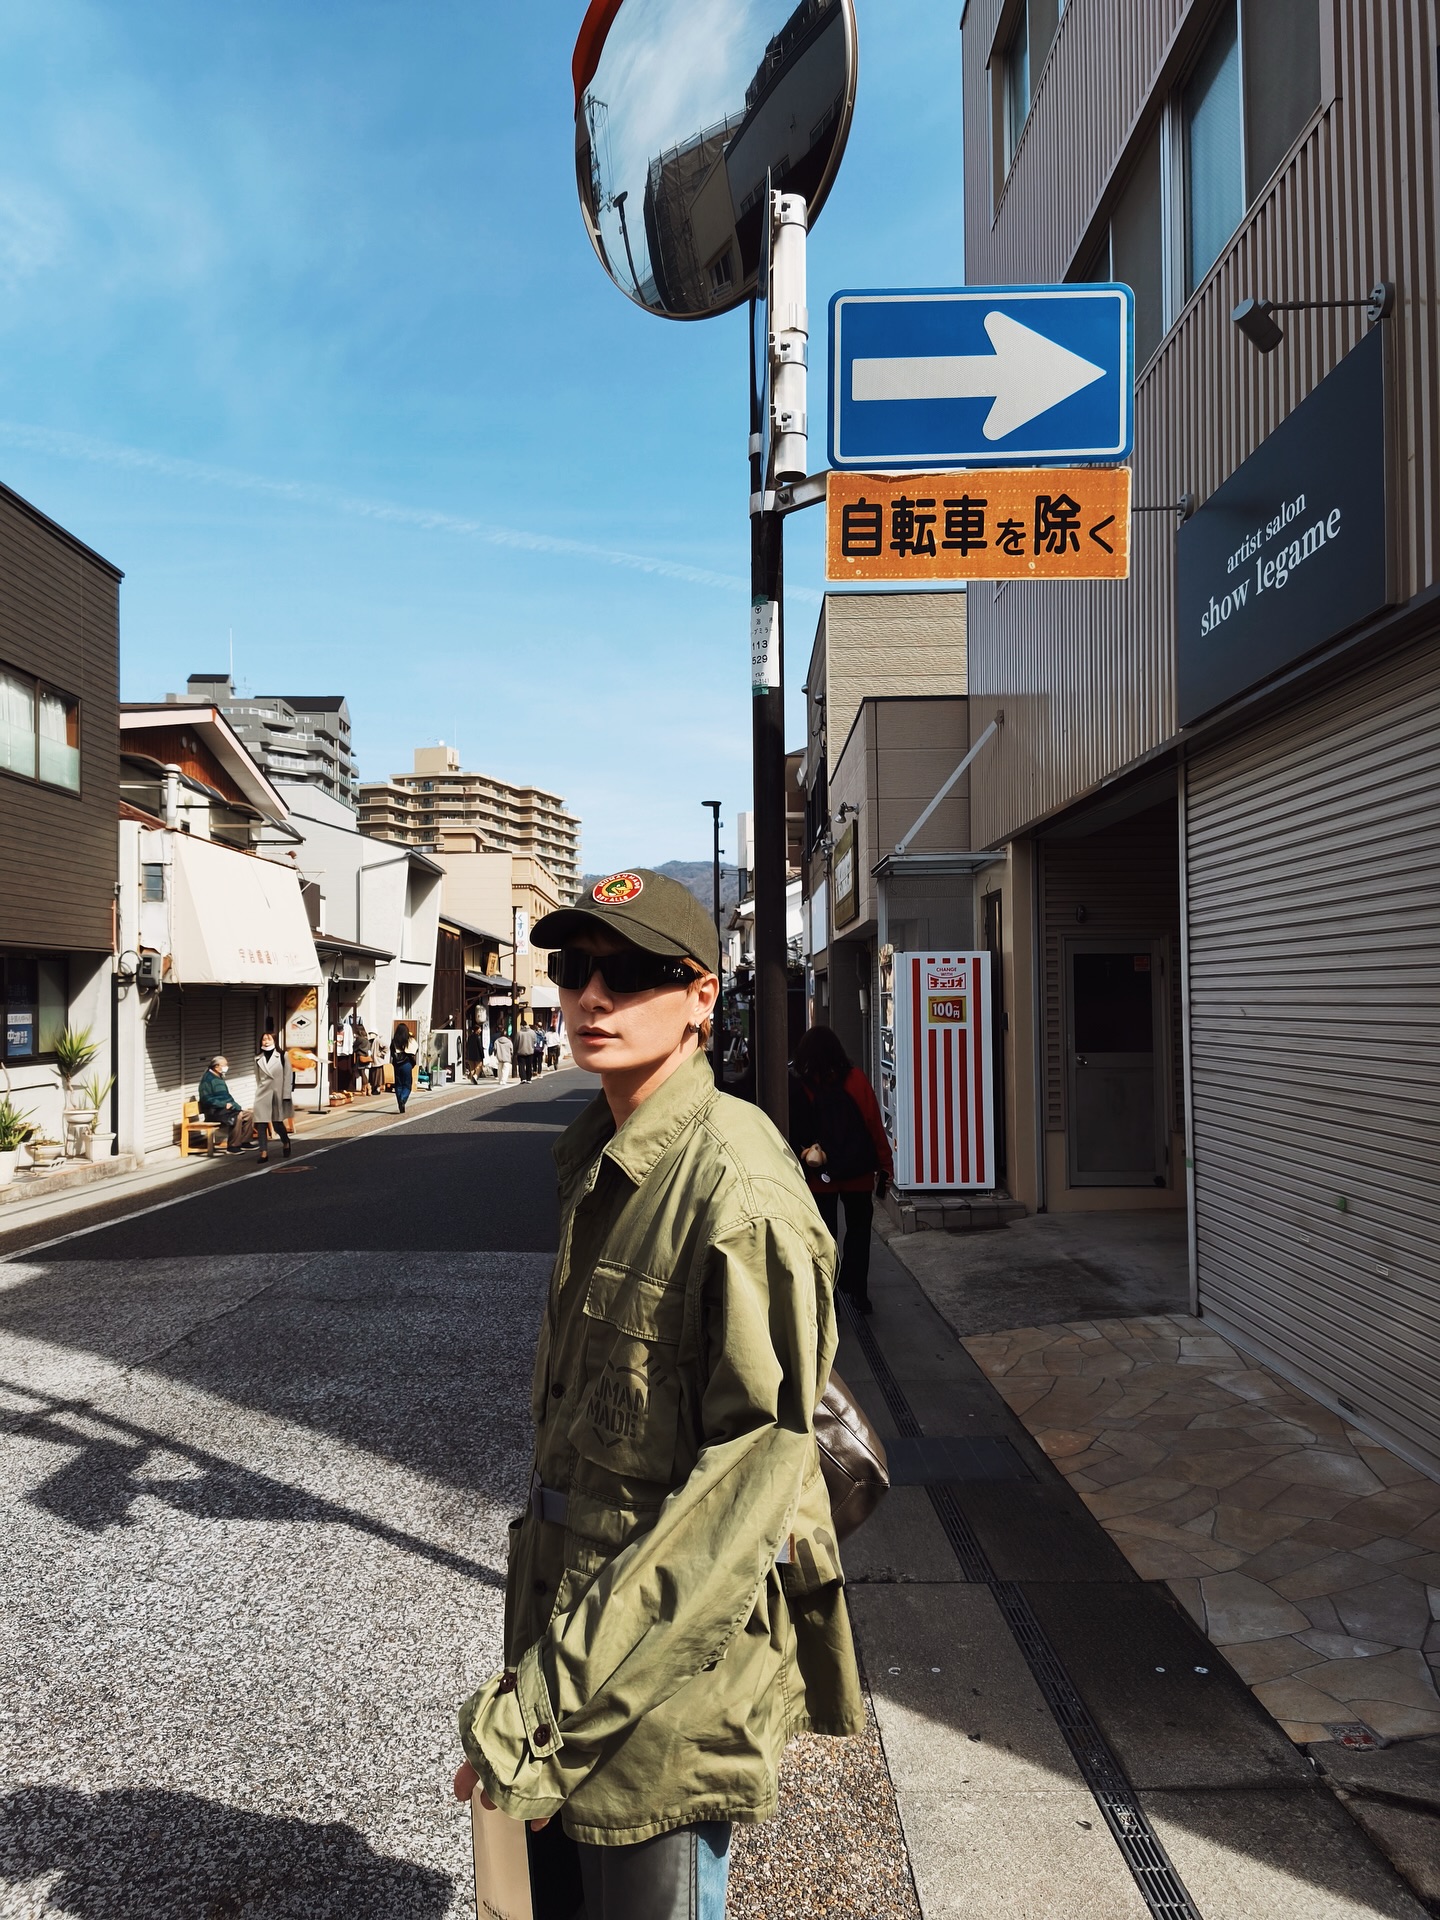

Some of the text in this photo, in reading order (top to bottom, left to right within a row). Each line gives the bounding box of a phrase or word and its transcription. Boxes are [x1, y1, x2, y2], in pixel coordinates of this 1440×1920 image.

[841, 494, 1115, 558] 自転車を除く
[1227, 493, 1307, 574] artist salon
[1200, 507, 1341, 637] show legame
[752, 655, 768, 665] 529
[930, 977, 964, 988] チェリオ
[594, 1375, 651, 1415] UMAN
[586, 1397, 639, 1438] MADE
